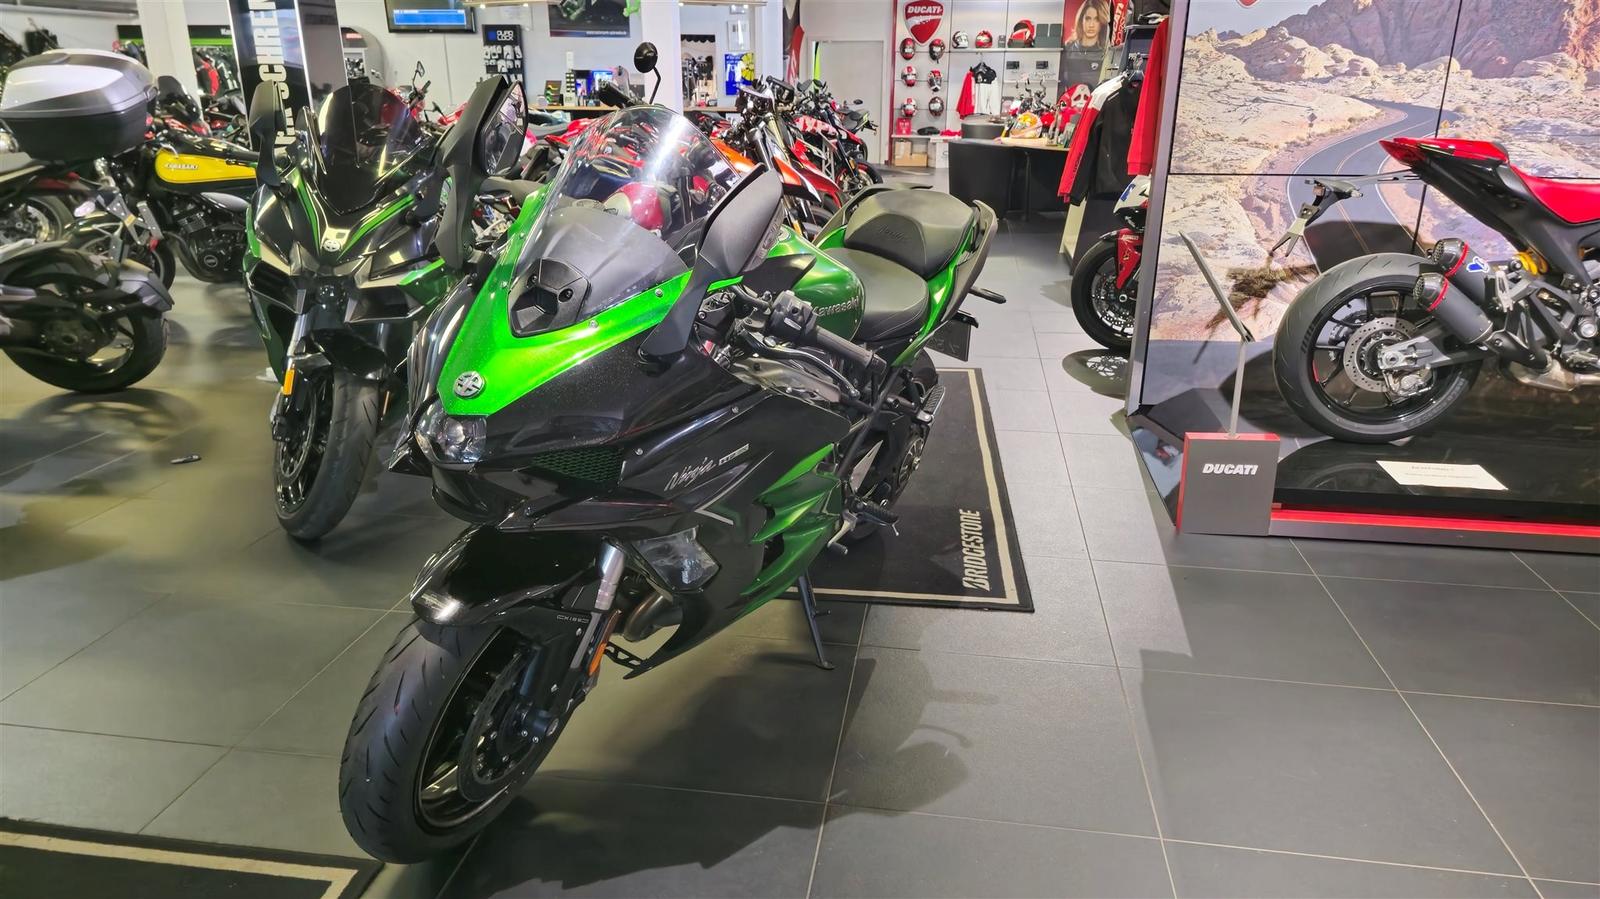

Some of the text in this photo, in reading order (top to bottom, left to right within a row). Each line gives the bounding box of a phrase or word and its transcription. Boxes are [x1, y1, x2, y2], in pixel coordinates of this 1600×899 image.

[907, 5, 943, 14] DUCATI
[663, 456, 717, 492] Ninja
[1202, 463, 1259, 476] DUCATI
[959, 508, 990, 592] BRIDGESTONE
